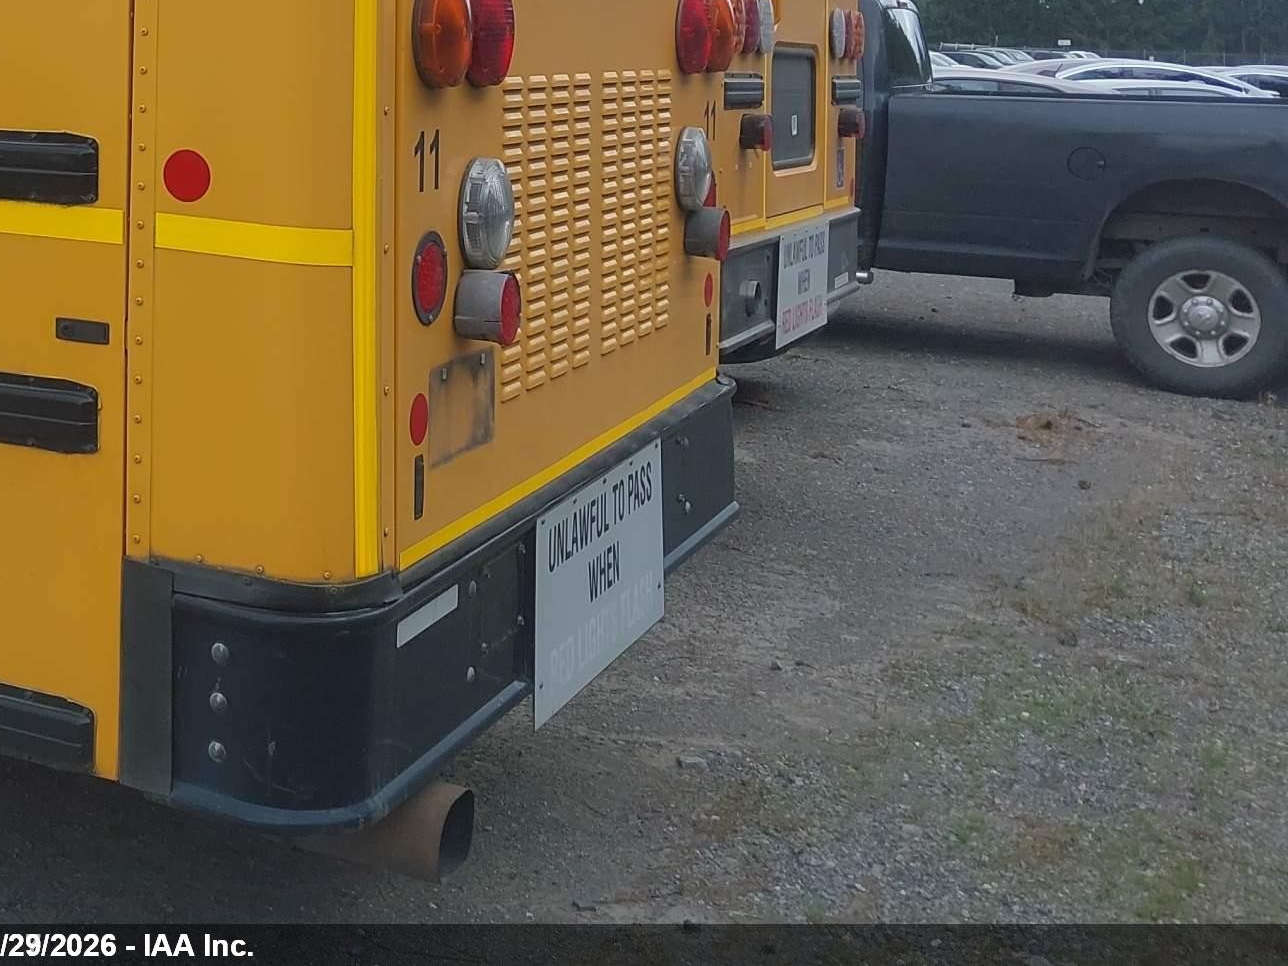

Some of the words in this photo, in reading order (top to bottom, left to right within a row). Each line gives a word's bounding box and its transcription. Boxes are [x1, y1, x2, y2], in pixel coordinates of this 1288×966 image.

[704, 100, 716, 142] 11
[414, 129, 440, 193] 11
[548, 491, 610, 573] UNLAWFUL
[612, 479, 625, 525] TO
[627, 461, 653, 515] PASS
[588, 540, 620, 603] WHEN
